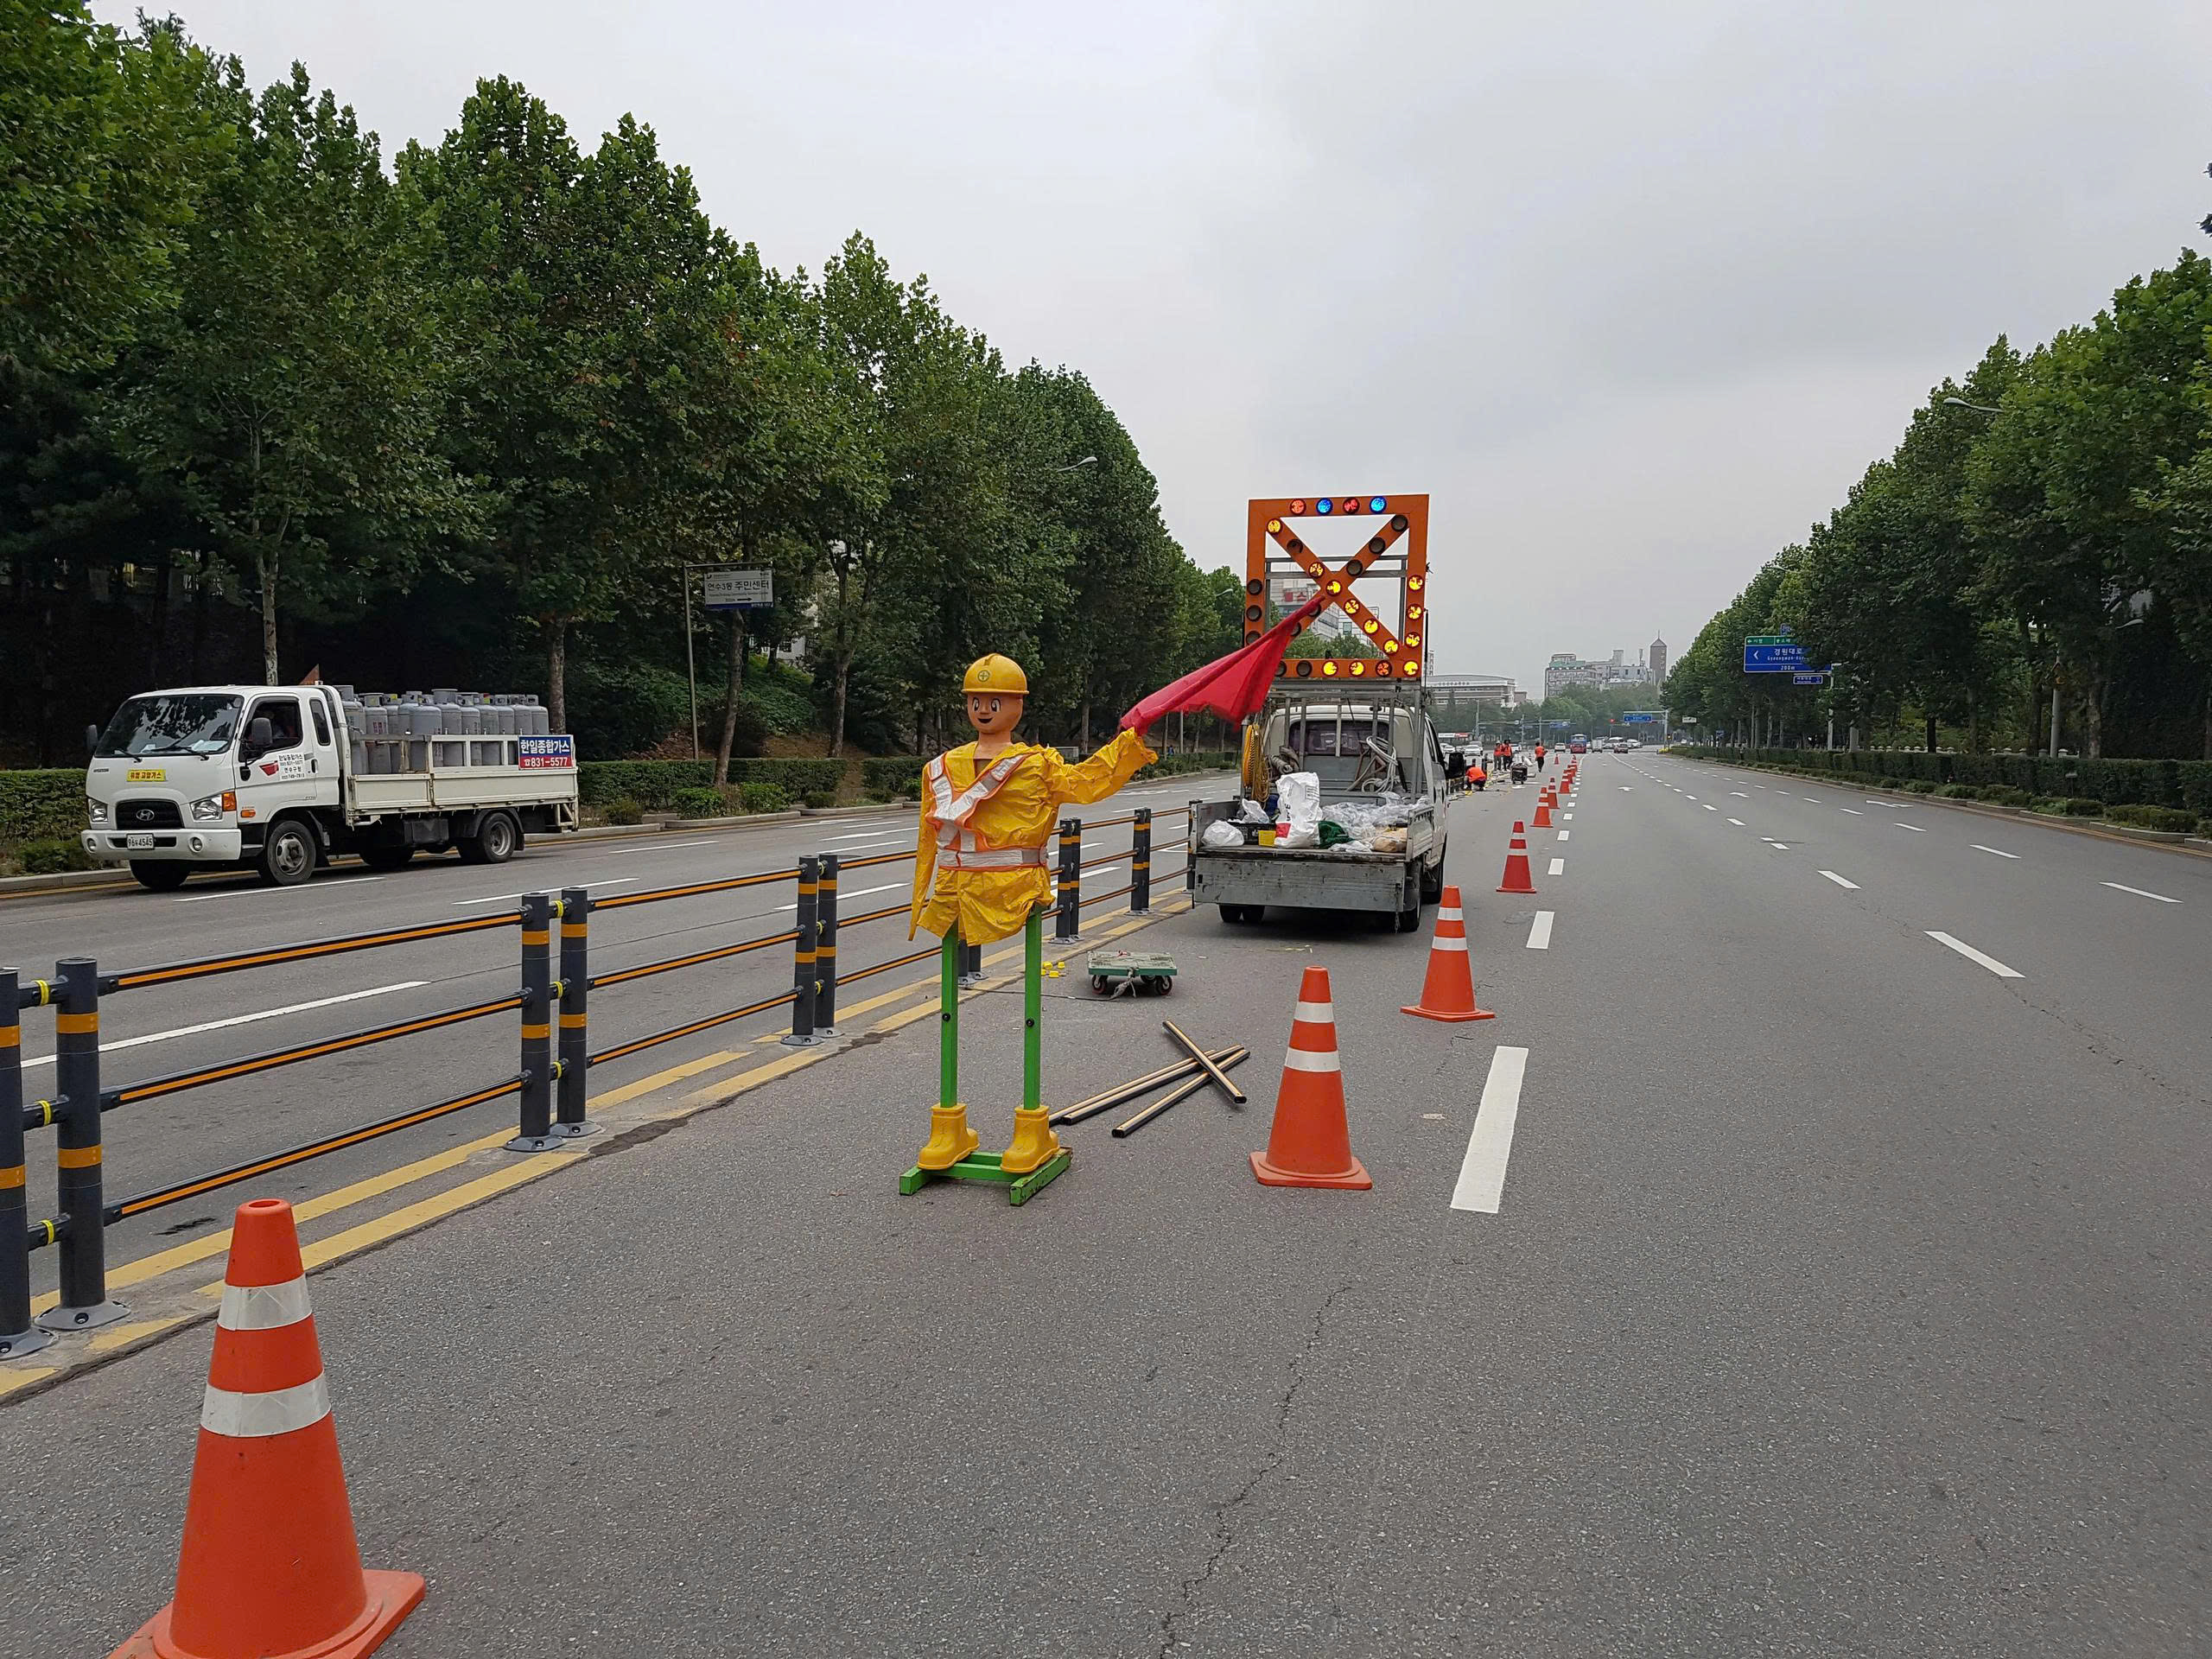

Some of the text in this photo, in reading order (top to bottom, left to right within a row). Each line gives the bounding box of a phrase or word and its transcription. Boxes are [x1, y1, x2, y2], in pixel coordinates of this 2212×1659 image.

[734, 580, 769, 590] 주민센터
[520, 739, 570, 754] 한일종합가스
[531, 757, 568, 767] 831-5577
